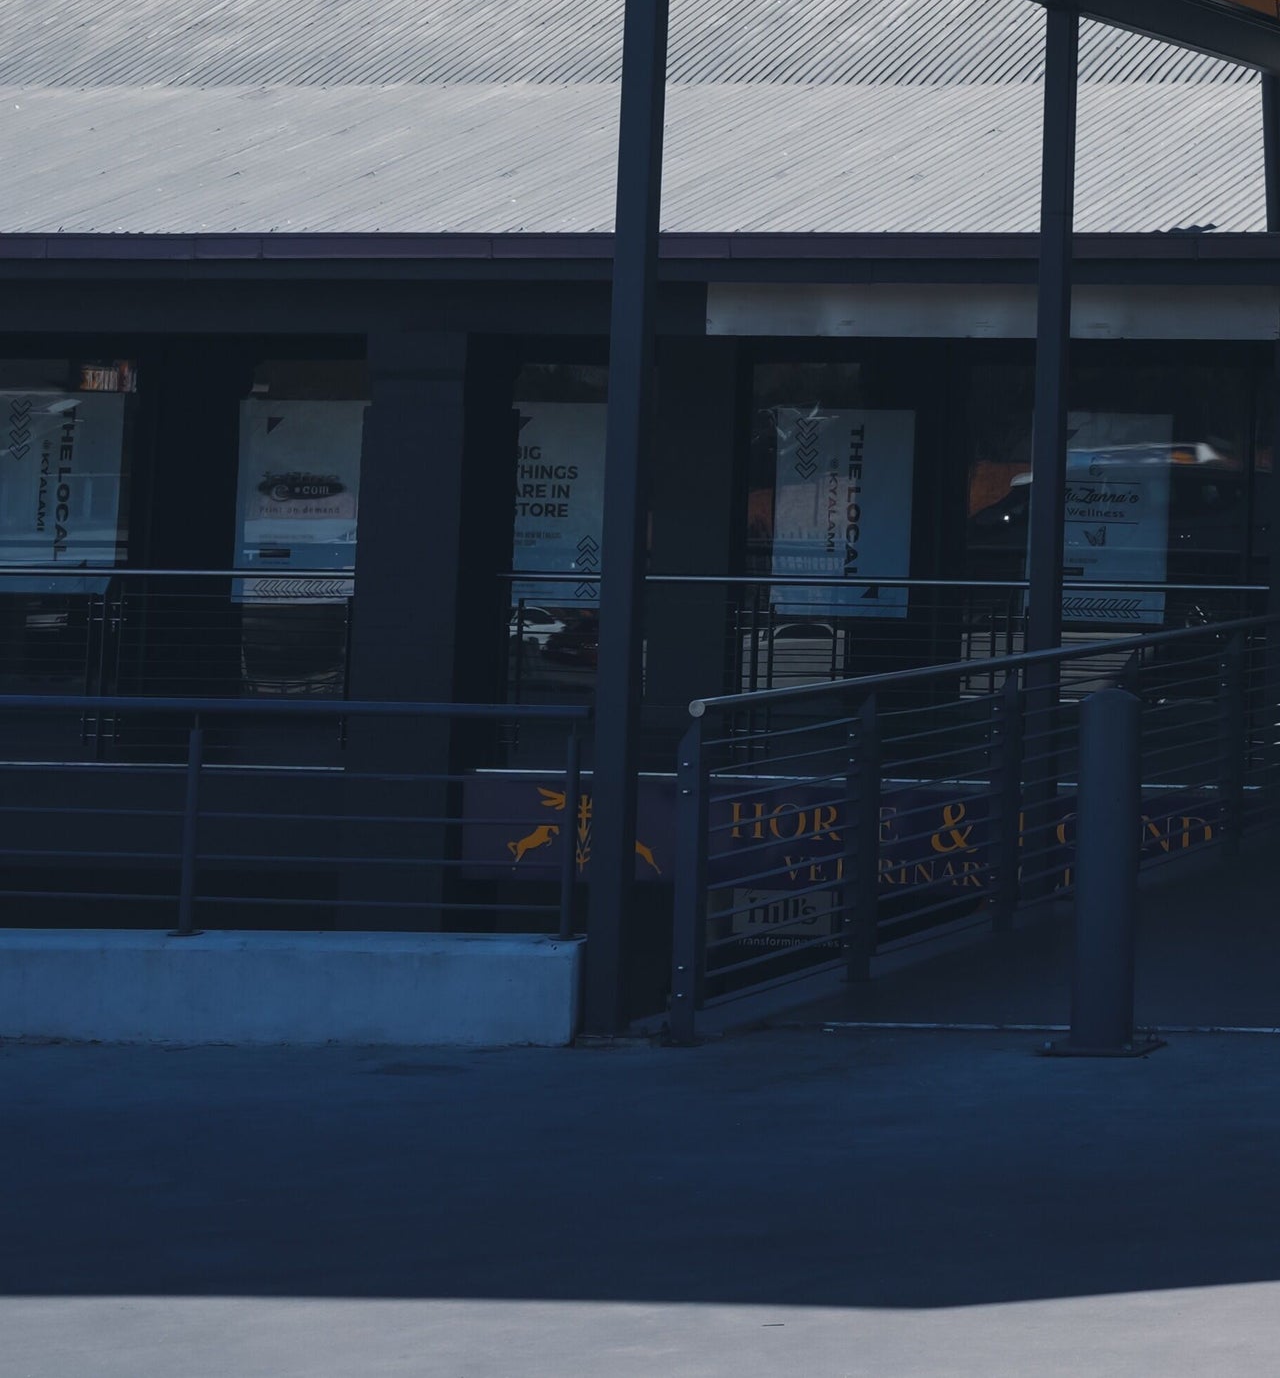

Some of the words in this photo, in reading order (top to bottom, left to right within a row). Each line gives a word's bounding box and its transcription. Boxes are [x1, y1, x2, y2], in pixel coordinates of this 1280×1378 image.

[60, 407, 76, 461] THE
[849, 424, 865, 480] THE
[37, 453, 50, 532] KYALAMI
[517, 465, 578, 480] HINGS
[551, 484, 570, 498] IN
[54, 467, 71, 561] LOCAL
[826, 472, 838, 552] KYALAMI
[844, 486, 861, 577] LOCAL
[1066, 506, 1126, 518] Wellness
[729, 801, 899, 844] HORE
[930, 802, 979, 854] &
